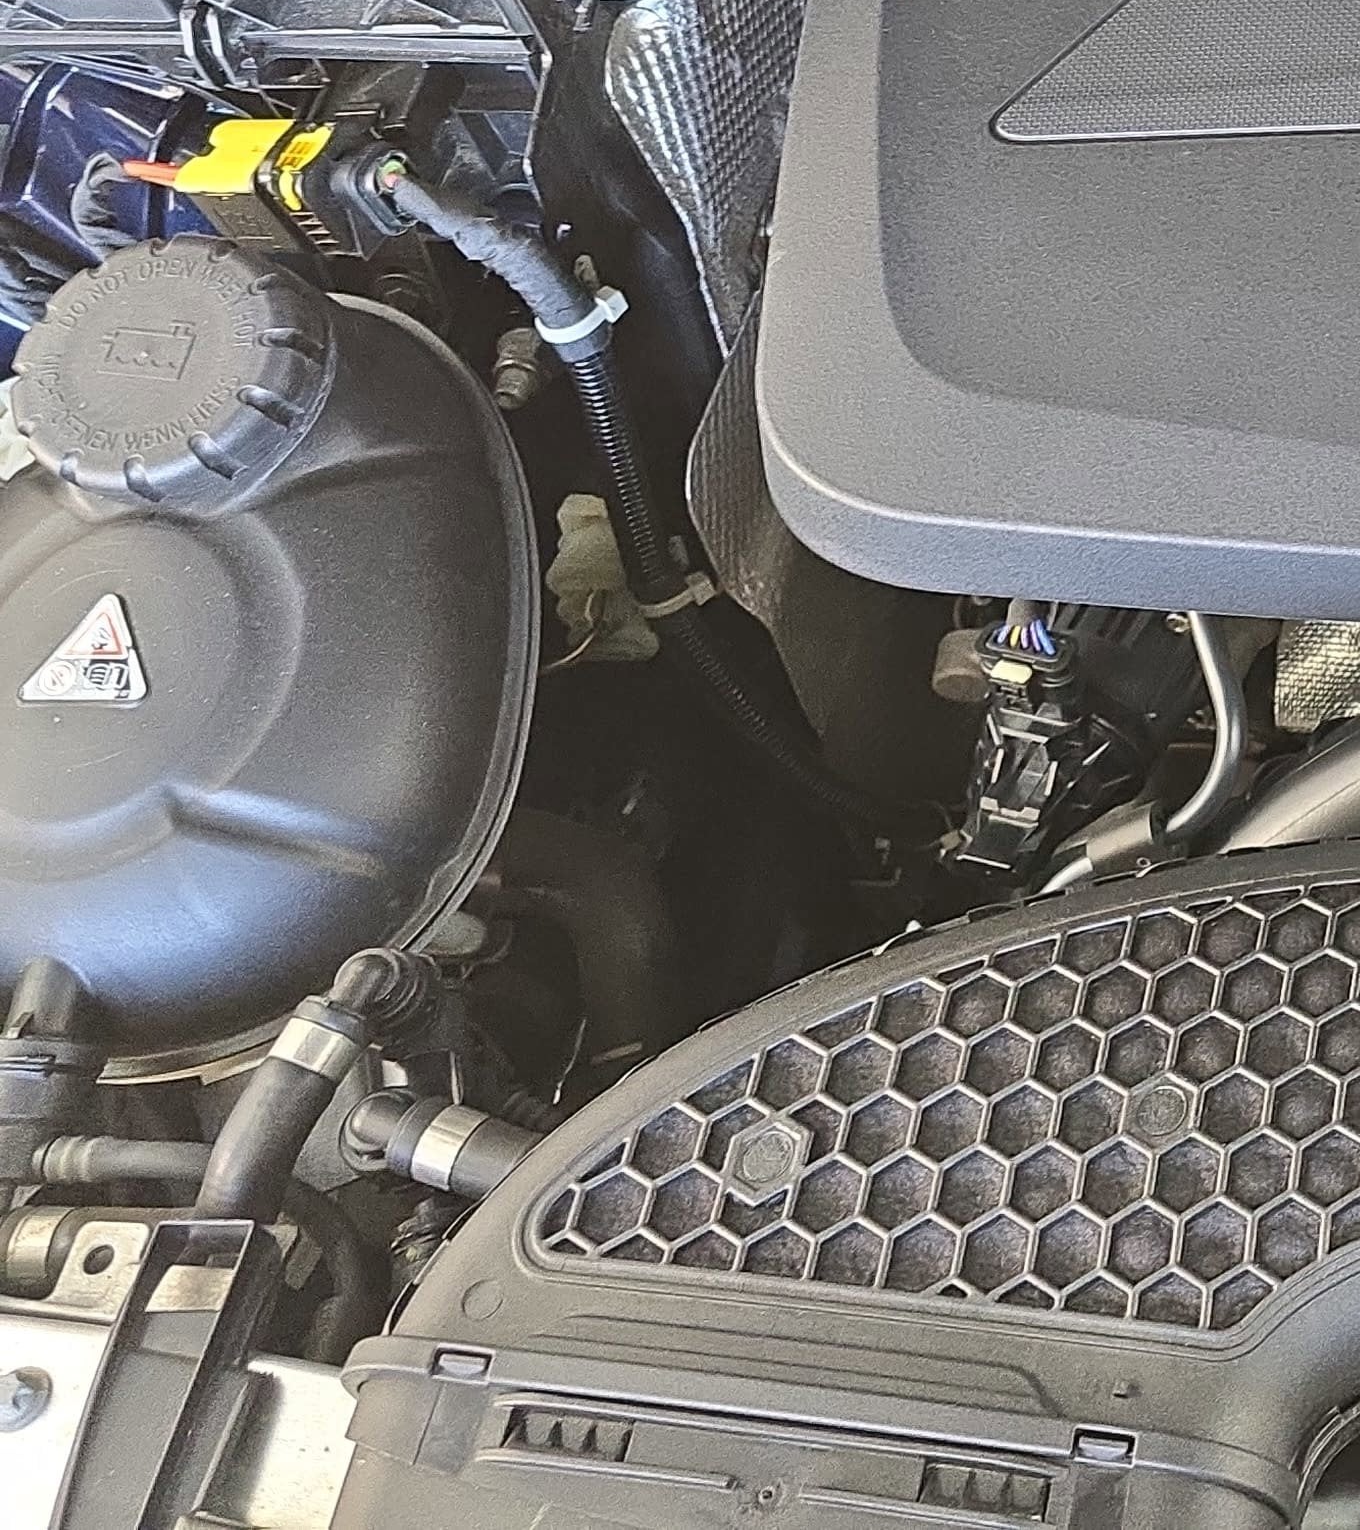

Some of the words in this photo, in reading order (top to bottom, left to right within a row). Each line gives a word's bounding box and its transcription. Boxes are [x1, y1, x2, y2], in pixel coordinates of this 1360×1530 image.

[57, 301, 88, 330] DO
[88, 271, 128, 304] NOT
[138, 259, 198, 281] OPEN
[231, 310, 258, 349] HOT
[124, 422, 187, 451] WENN
